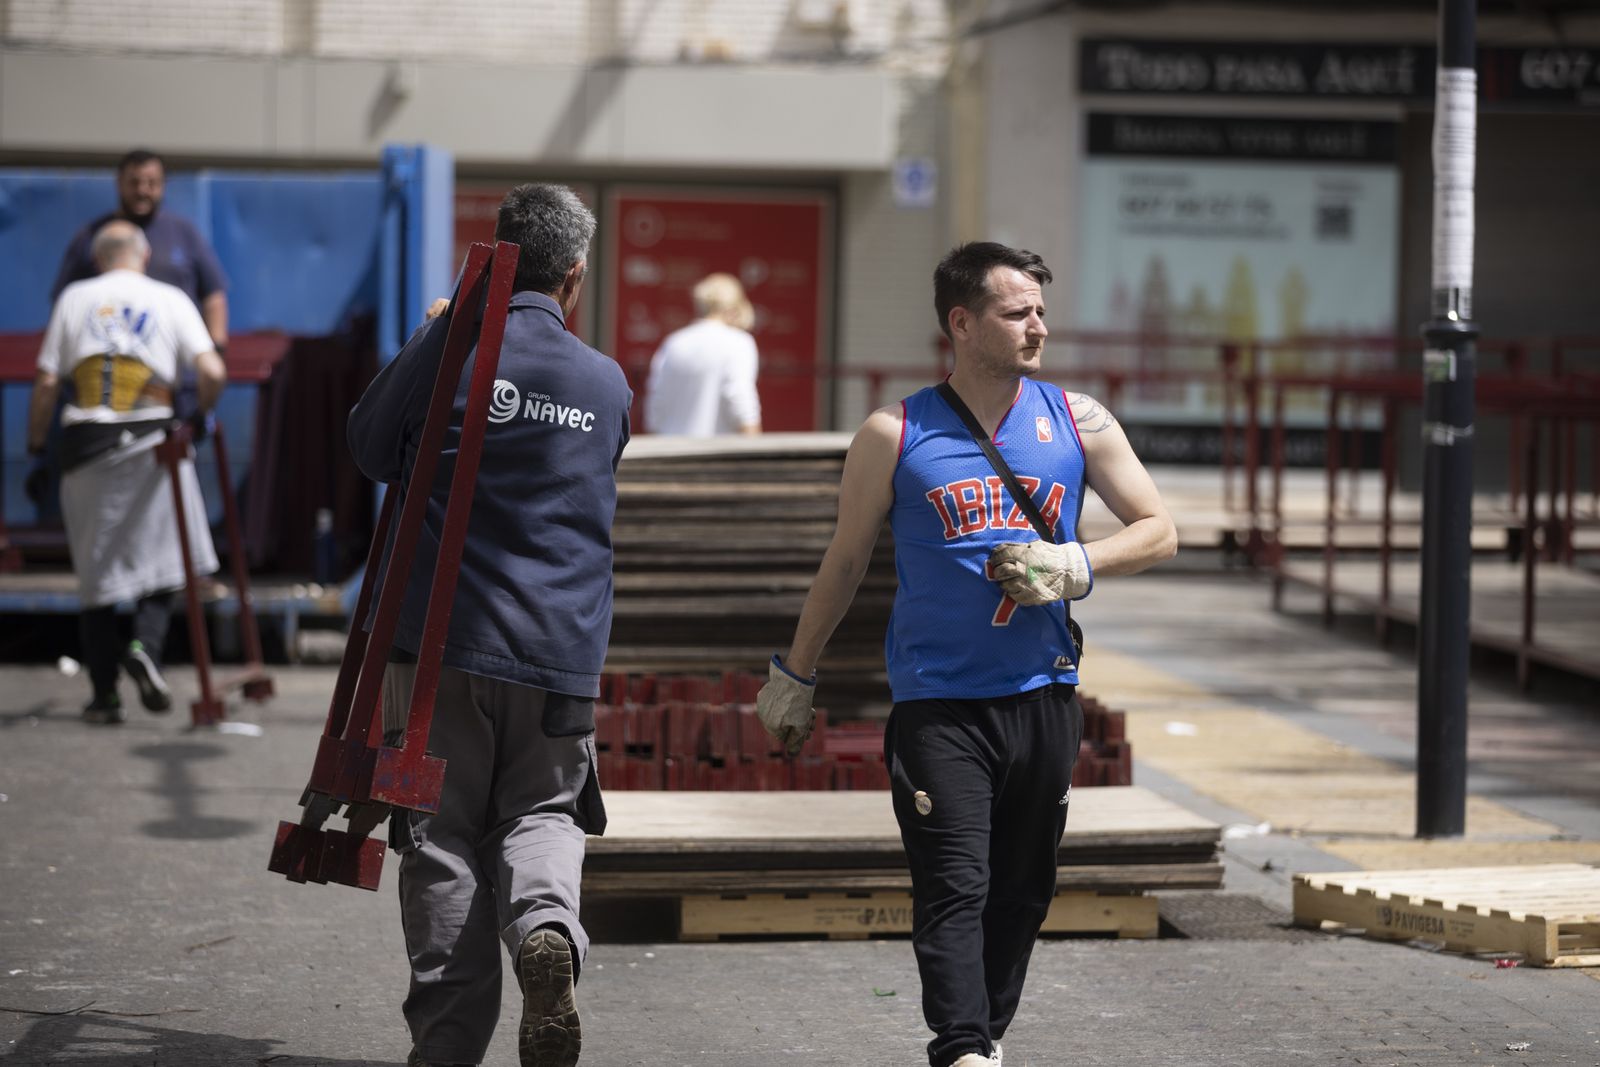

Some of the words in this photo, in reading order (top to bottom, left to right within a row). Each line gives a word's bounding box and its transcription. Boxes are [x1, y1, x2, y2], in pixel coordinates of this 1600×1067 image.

[527, 391, 551, 402] GRUPO
[926, 476, 1066, 541] IBIZA
[1394, 909, 1446, 936] PAVIGESA
